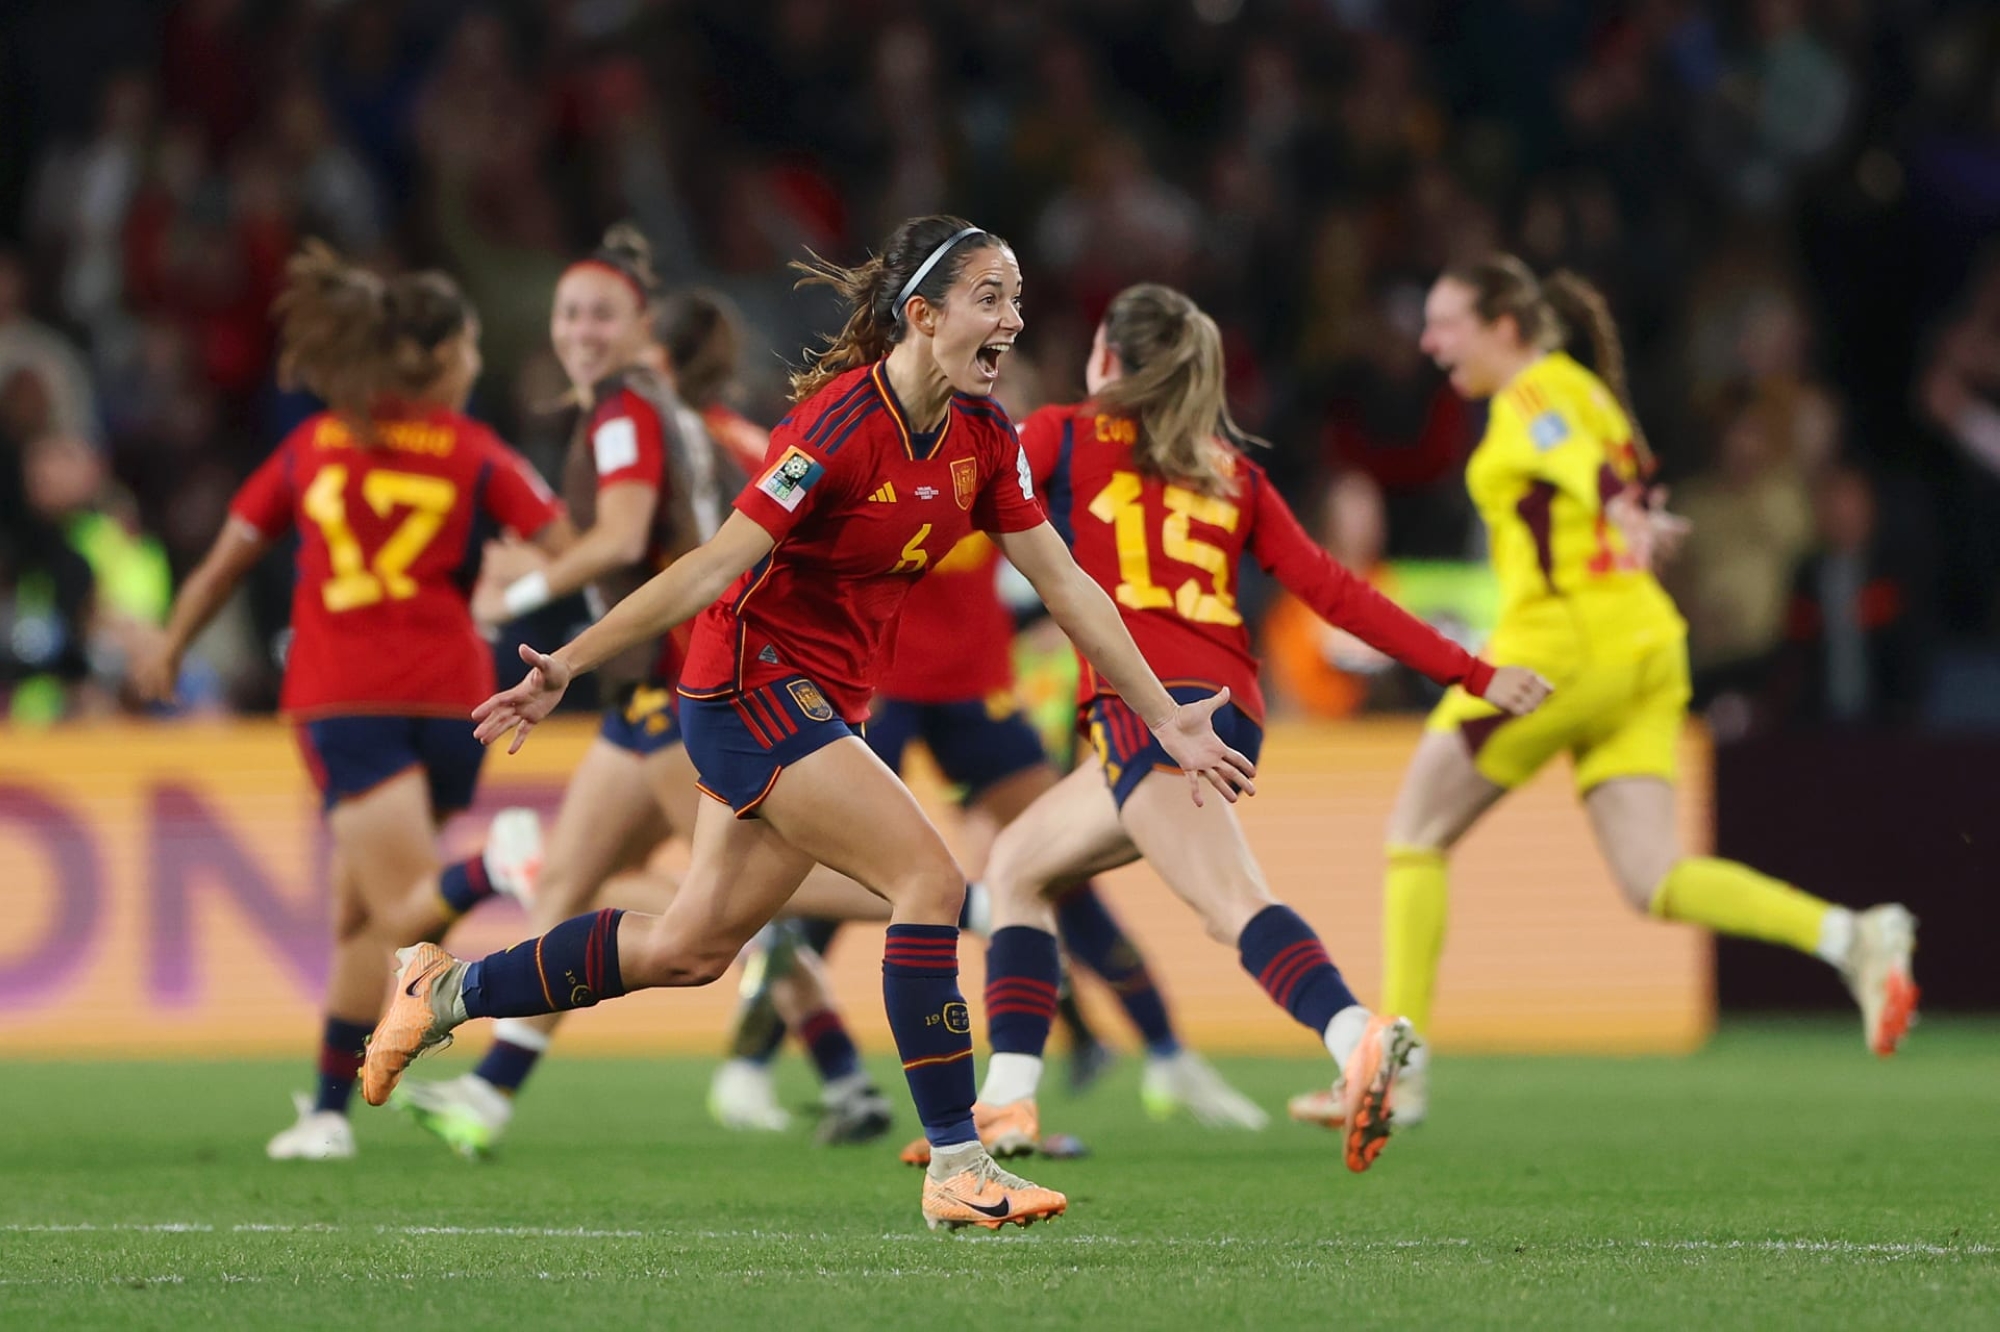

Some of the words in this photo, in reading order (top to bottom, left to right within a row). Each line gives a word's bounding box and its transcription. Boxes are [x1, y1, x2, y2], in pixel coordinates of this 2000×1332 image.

[303, 463, 458, 613] 17
[888, 523, 932, 573] 6
[1088, 470, 1244, 626] 15
